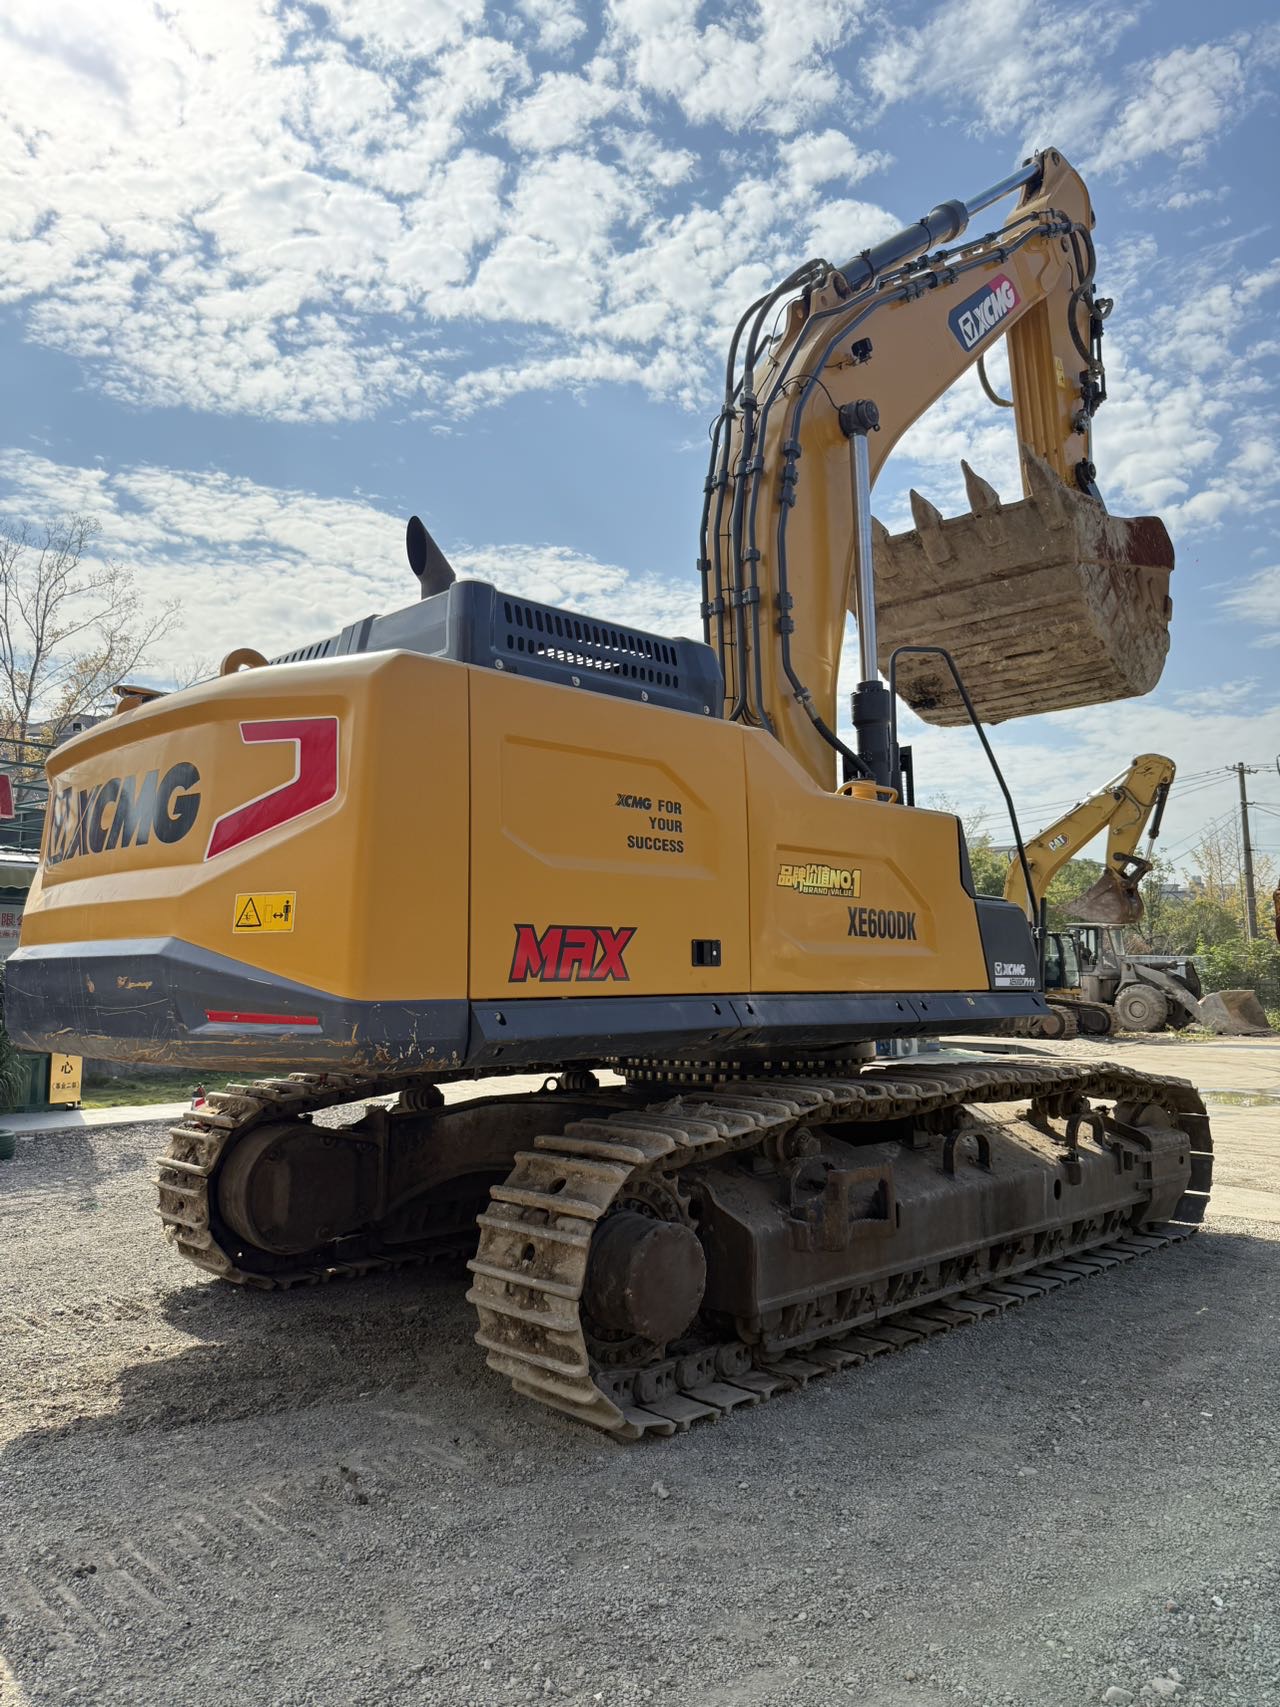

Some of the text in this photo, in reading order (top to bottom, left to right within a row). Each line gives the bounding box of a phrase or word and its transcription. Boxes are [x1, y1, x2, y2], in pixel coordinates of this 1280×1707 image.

[972, 280, 1015, 336] XCMG
[63, 761, 201, 860] XCMG
[616, 793, 682, 815] XCMG FOR
[649, 816, 683, 833] YOUR
[627, 835, 684, 853] SUCCESS
[1048, 834, 1065, 851] CAT
[803, 885, 853, 897] BRAND VALUE
[847, 906, 917, 941] XE600DK
[508, 923, 637, 982] MAX
[1002, 963, 1026, 976] XCMG
